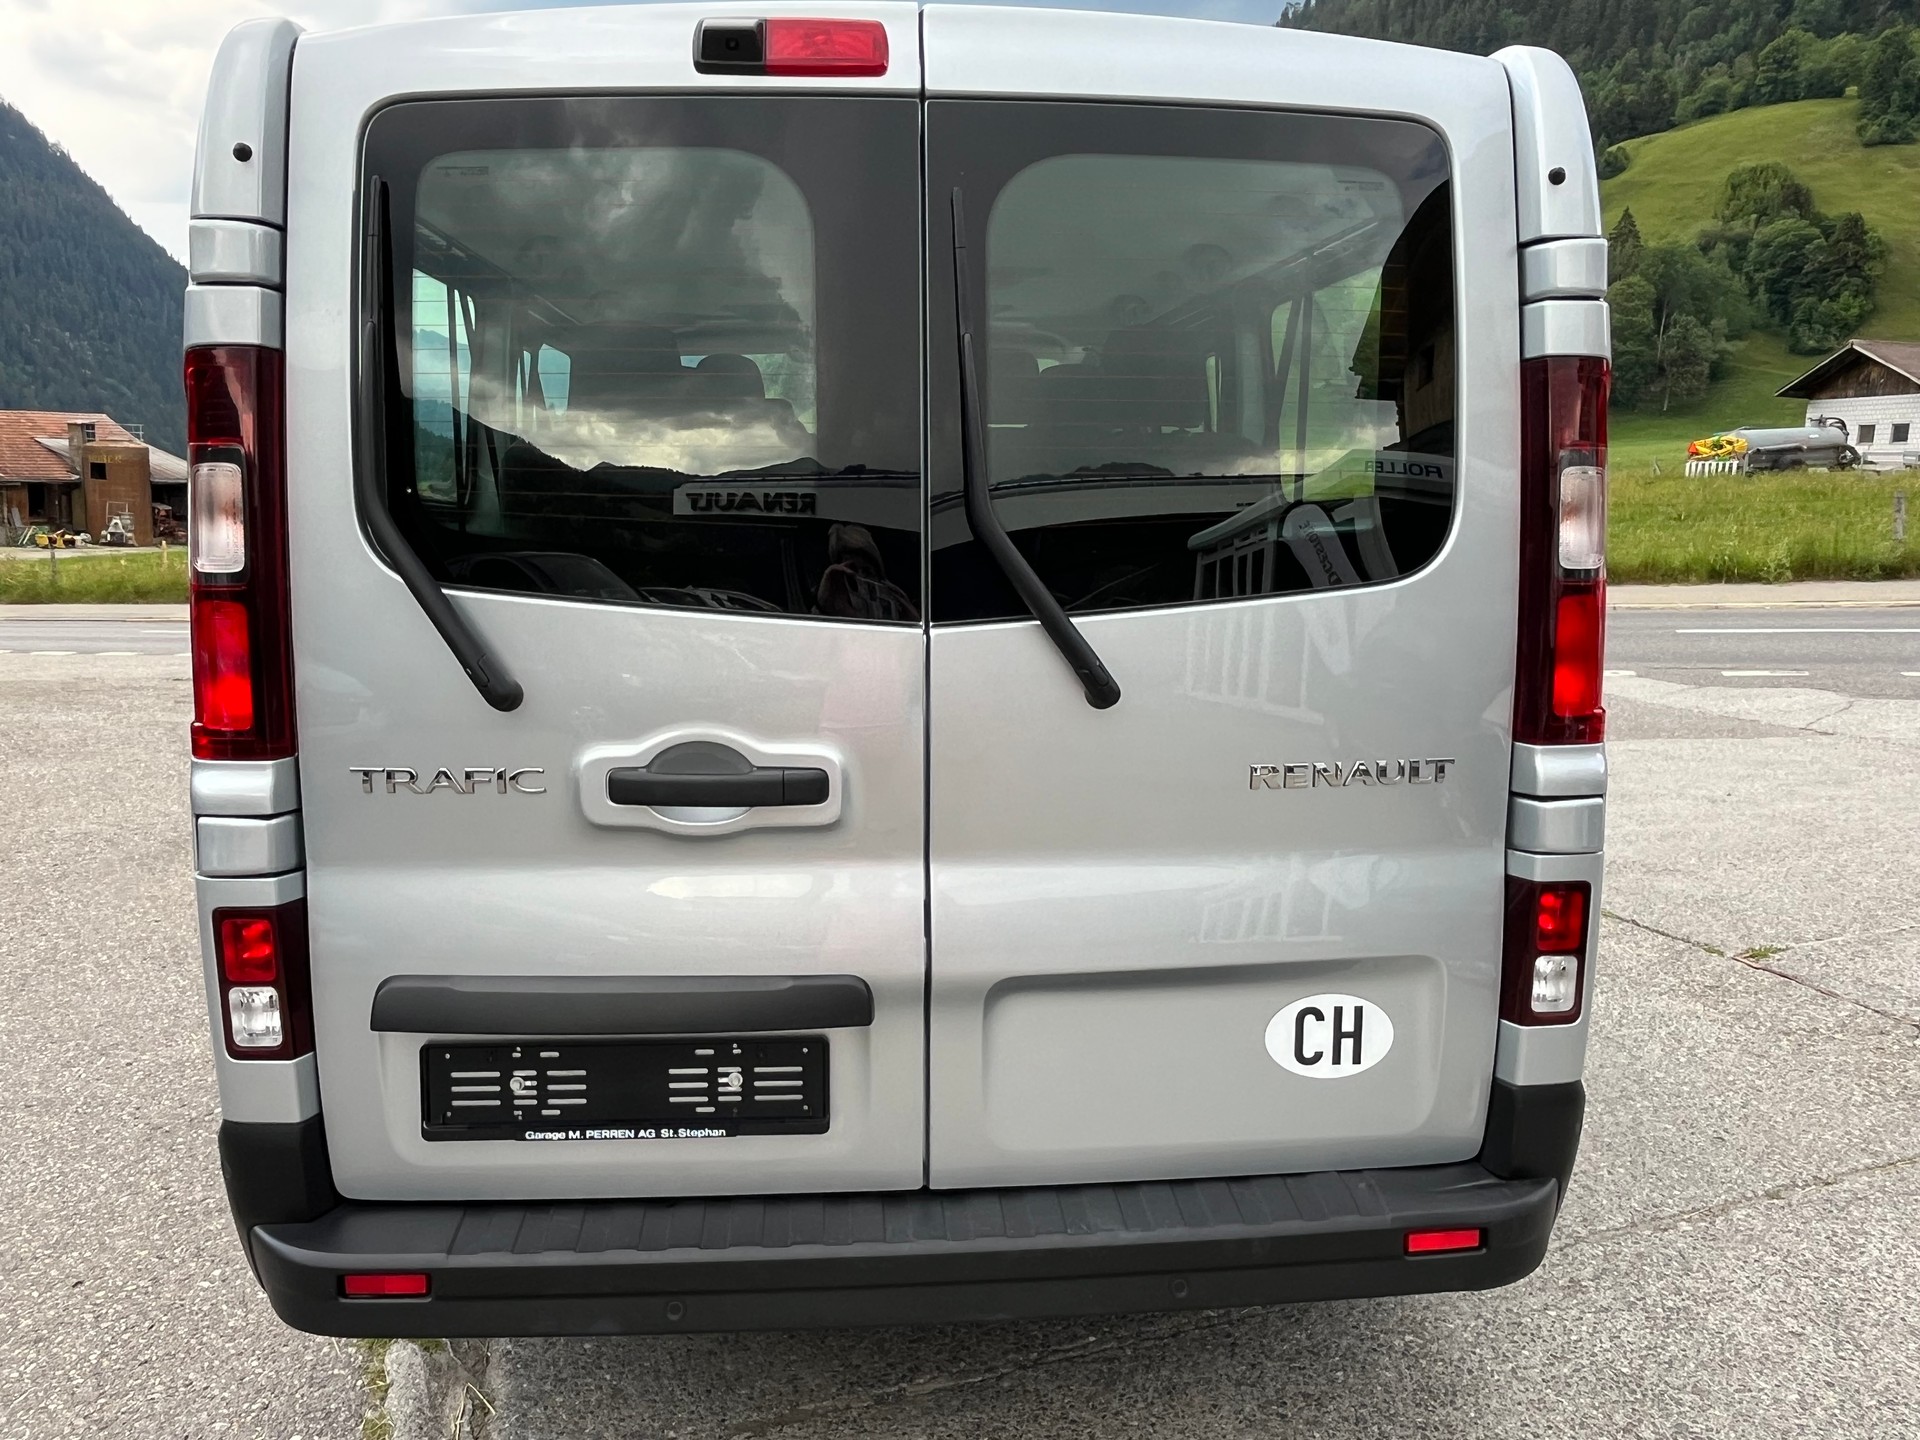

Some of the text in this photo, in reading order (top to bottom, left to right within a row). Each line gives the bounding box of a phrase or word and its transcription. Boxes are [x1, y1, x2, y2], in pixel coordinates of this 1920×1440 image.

[350, 767, 546, 794] TRAFIC
[1249, 757, 1456, 790] RENAULT
[1294, 1005, 1363, 1066] CH
[525, 1130, 566, 1140] Garage
[568, 1130, 584, 1139] M.
[585, 1129, 635, 1139] PERREN
[637, 1128, 656, 1138] AG
